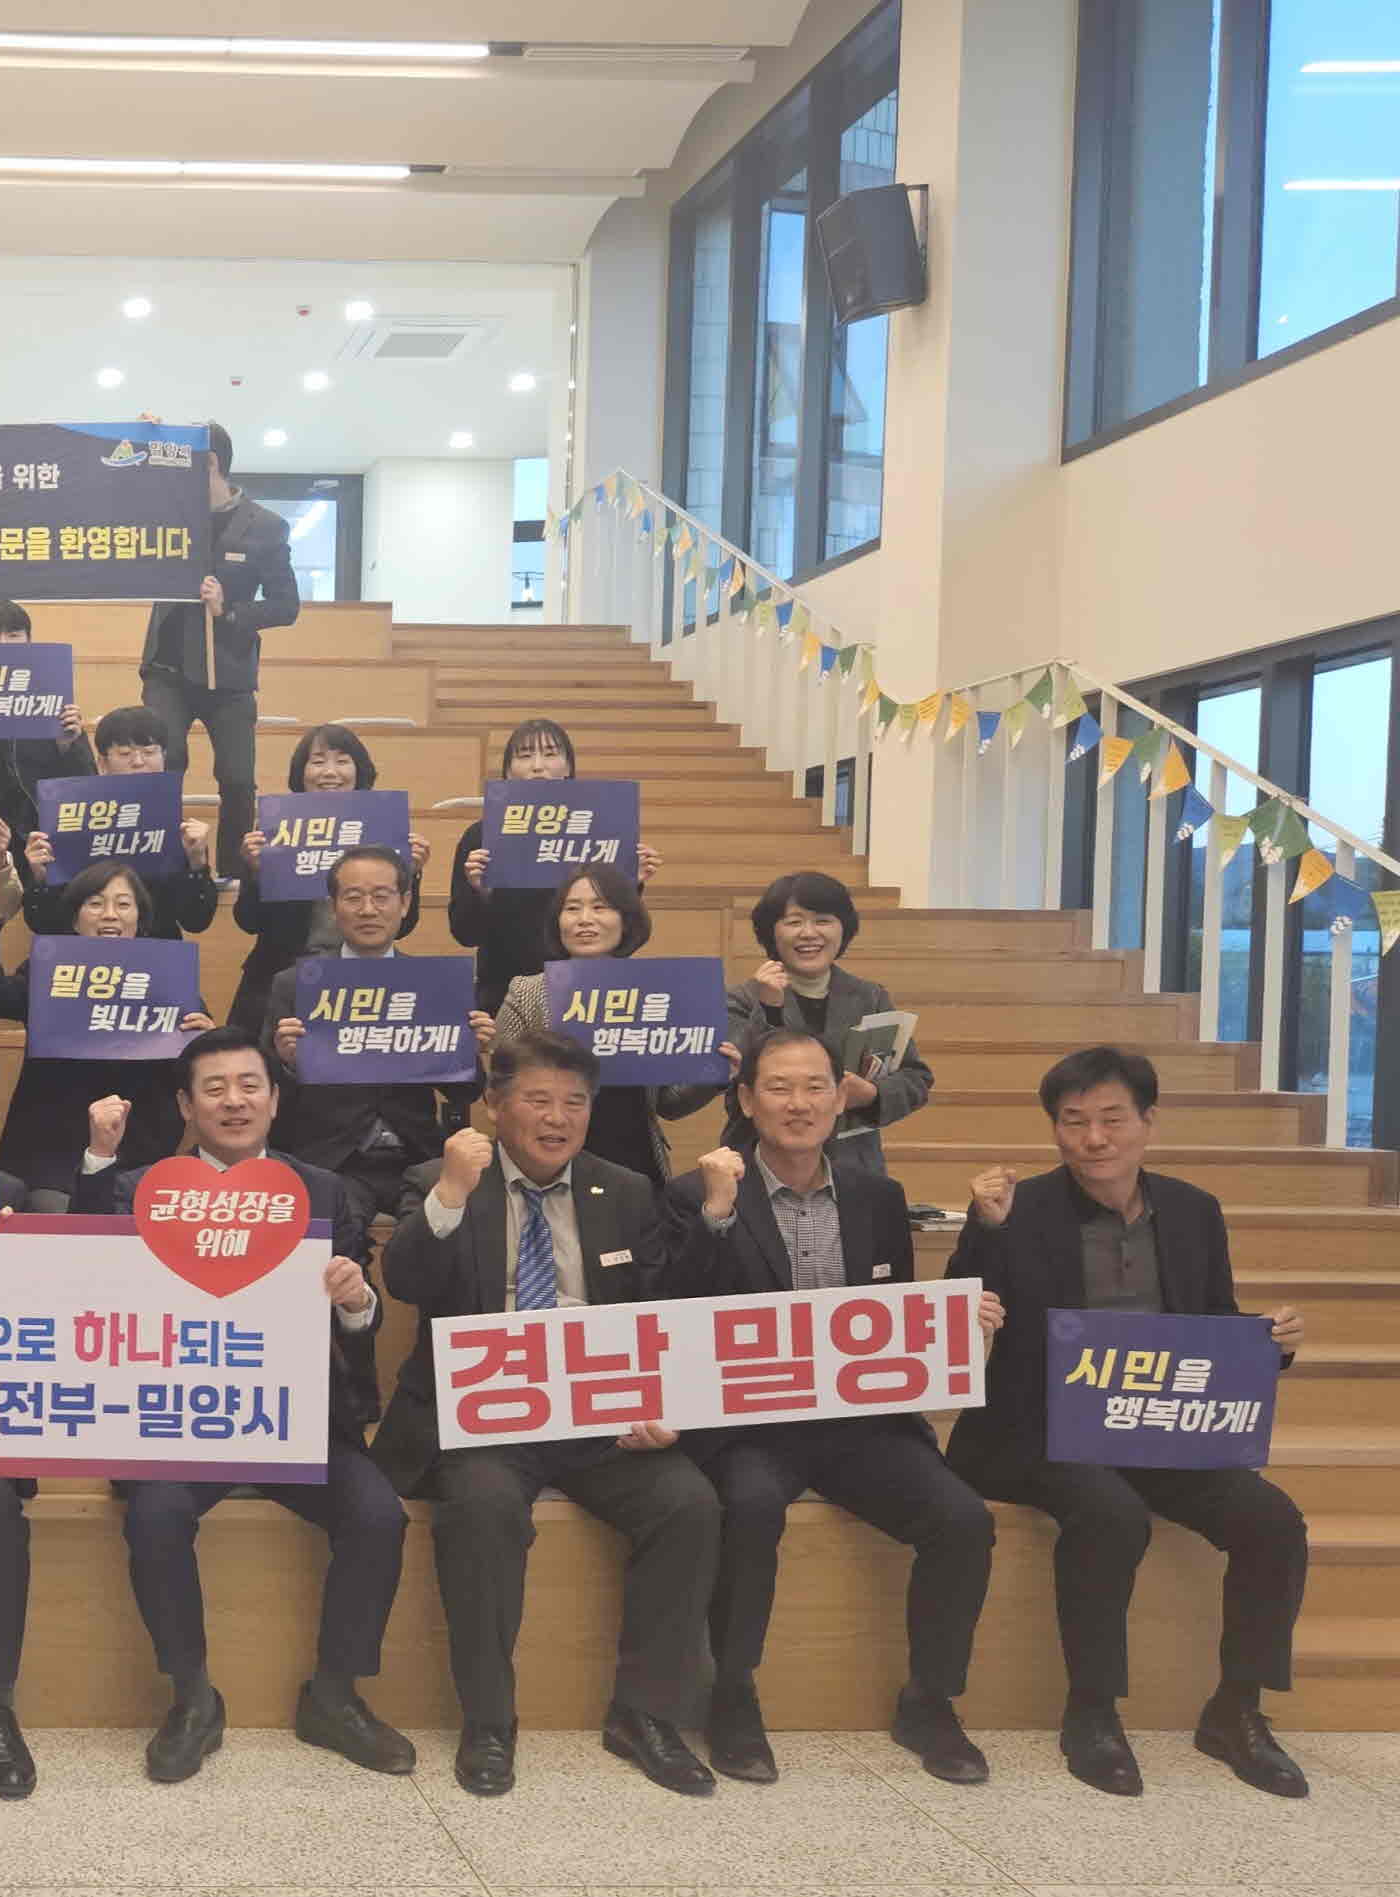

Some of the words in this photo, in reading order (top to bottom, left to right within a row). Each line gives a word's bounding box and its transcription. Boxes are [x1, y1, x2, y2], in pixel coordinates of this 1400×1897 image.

[12, 464, 61, 490] 위한
[59, 526, 192, 561] 환영합니다
[56, 800, 141, 832] 밀양을
[270, 816, 363, 847] 시민을
[501, 804, 594, 835] 밀양을
[89, 830, 166, 857] 빛나게
[535, 839, 620, 863] 빛나게
[50, 964, 151, 999] 밀양을
[88, 1004, 179, 1032] 빛나게
[309, 987, 417, 1022] 시민을
[562, 988, 671, 1023] 시민을
[336, 1025, 460, 1055] 행복하게!
[591, 1026, 715, 1056] 행복하게!
[149, 1188, 297, 1224] 균형성장을
[193, 1229, 250, 1258] 위해
[73, 1310, 265, 1368] 하나되는
[450, 1313, 670, 1435] 경남
[713, 1293, 971, 1415] 밀양!
[1064, 1348, 1213, 1393] 시민을
[1103, 1396, 1262, 1433] 행복하게!
